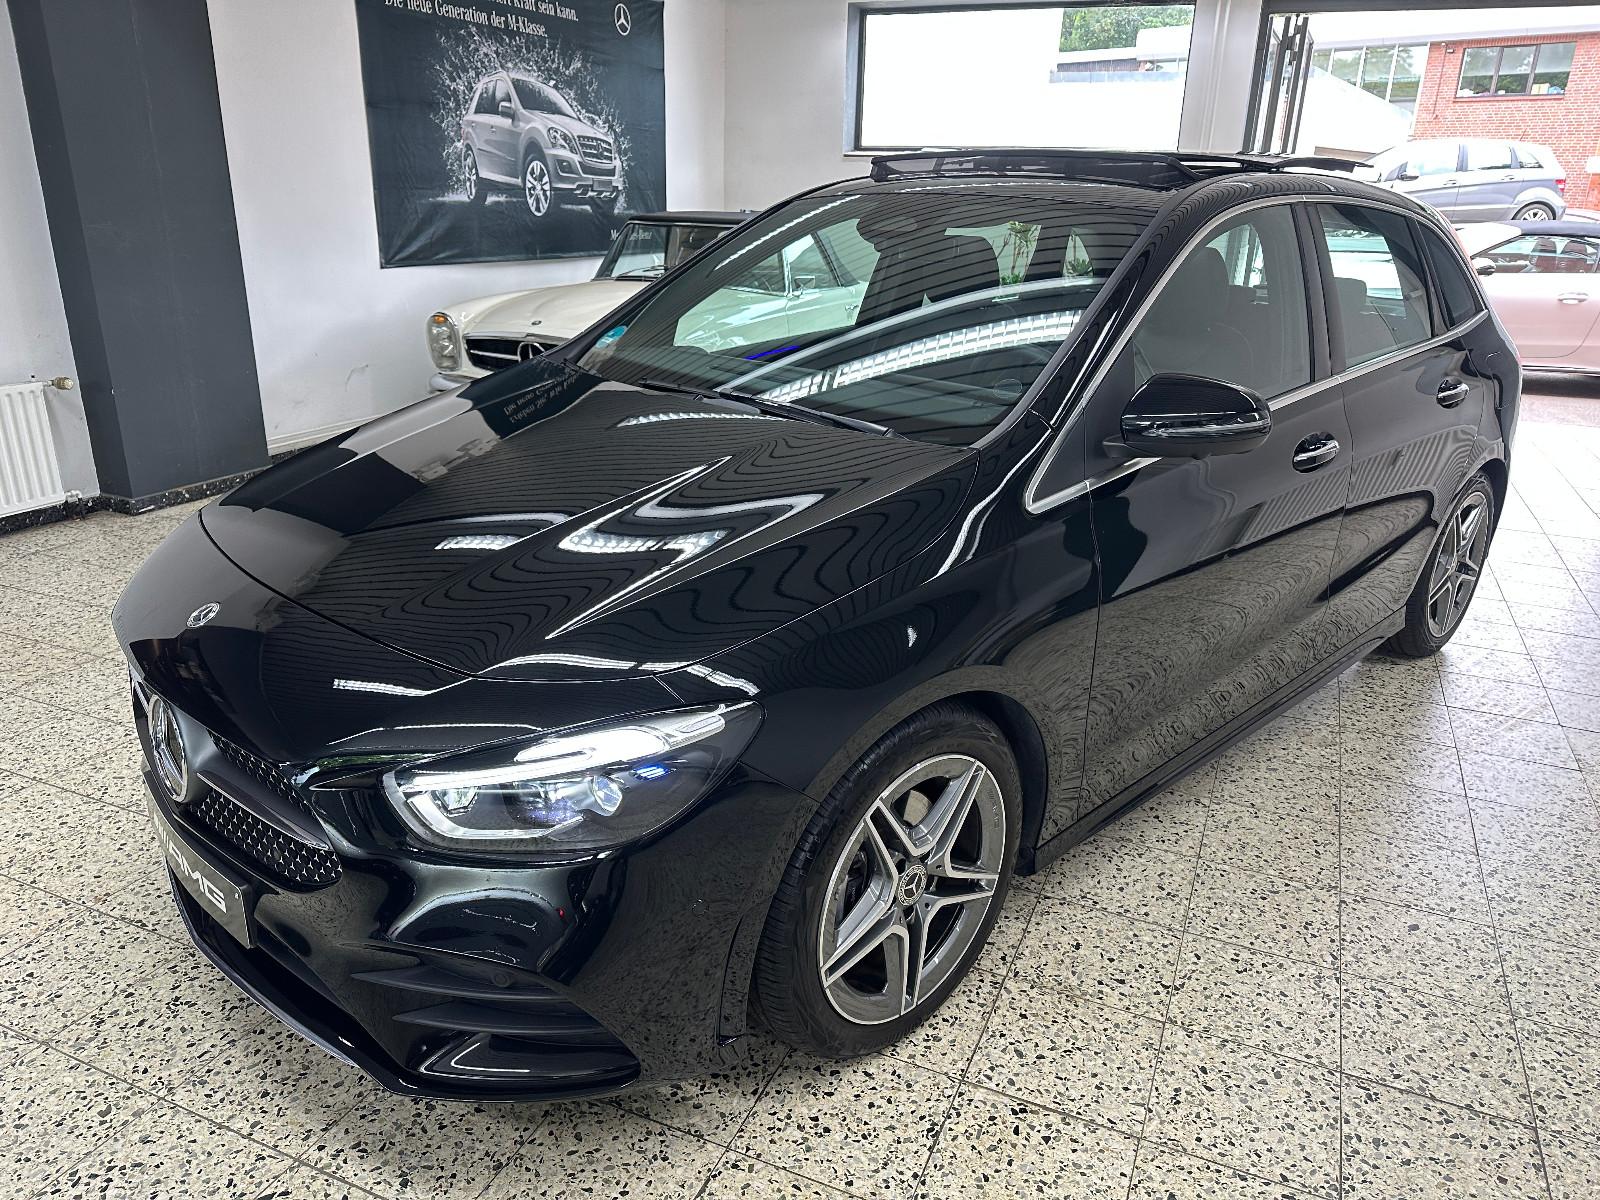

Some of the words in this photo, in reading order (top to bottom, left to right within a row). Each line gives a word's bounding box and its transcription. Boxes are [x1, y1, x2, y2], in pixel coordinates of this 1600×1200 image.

[407, 0, 432, 14] neue
[435, 0, 489, 25] Generation
[491, 11, 505, 29] der
[507, 14, 548, 37] M-Klasse.
[538, 0, 555, 16] sein
[556, 2, 579, 21] kann.
